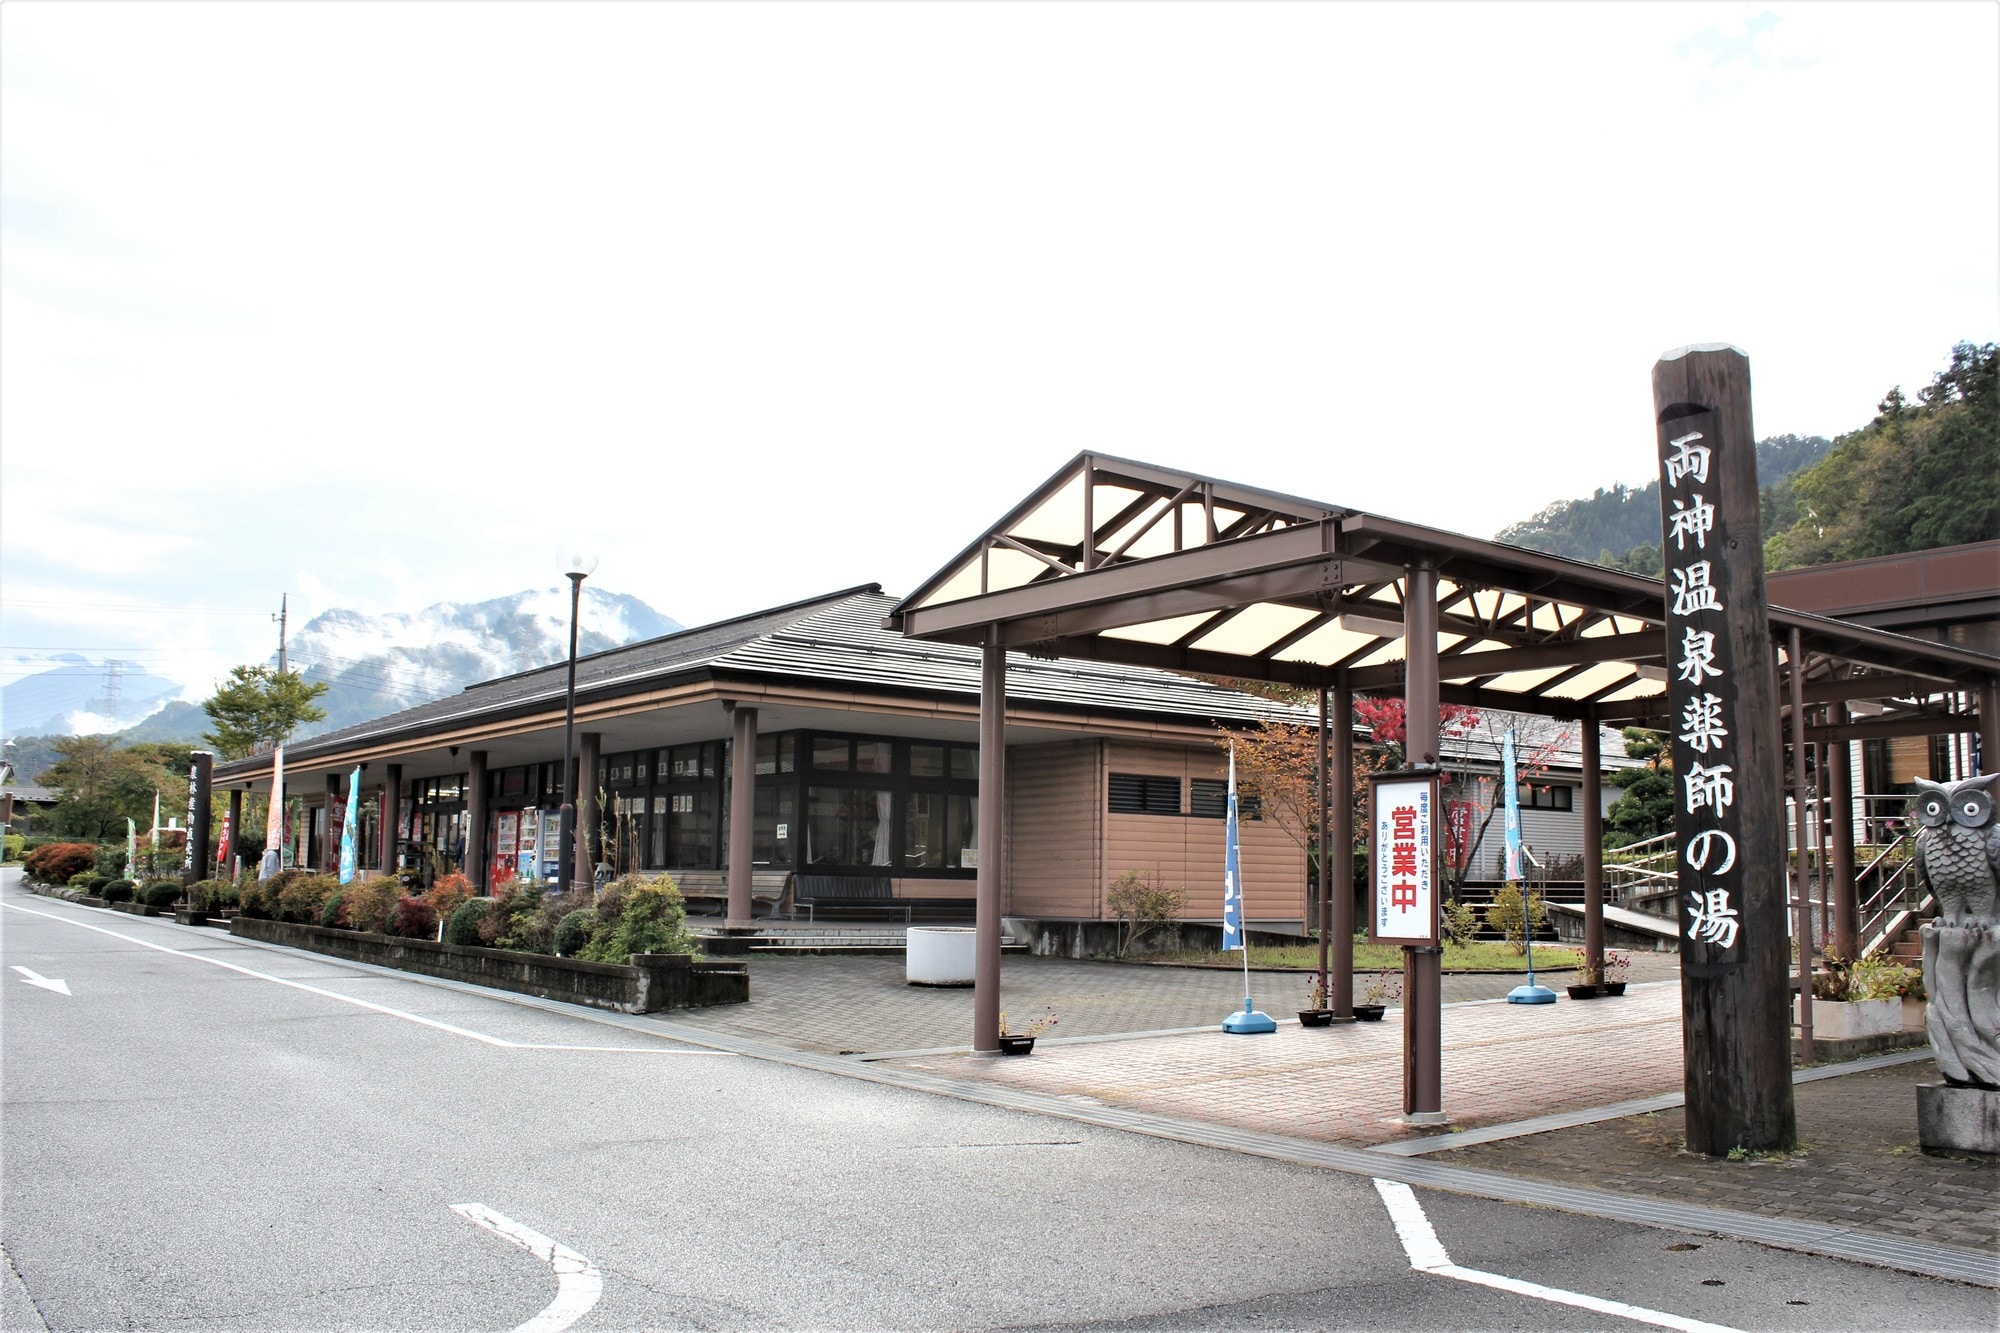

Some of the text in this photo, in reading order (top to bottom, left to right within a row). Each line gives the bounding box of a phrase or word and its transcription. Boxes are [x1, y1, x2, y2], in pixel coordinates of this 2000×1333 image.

[1665, 431, 1741, 950] 両神温泉薬師の湯
[1380, 821, 1388, 927] ありがとうございます
[1391, 805, 1417, 914] 営業中
